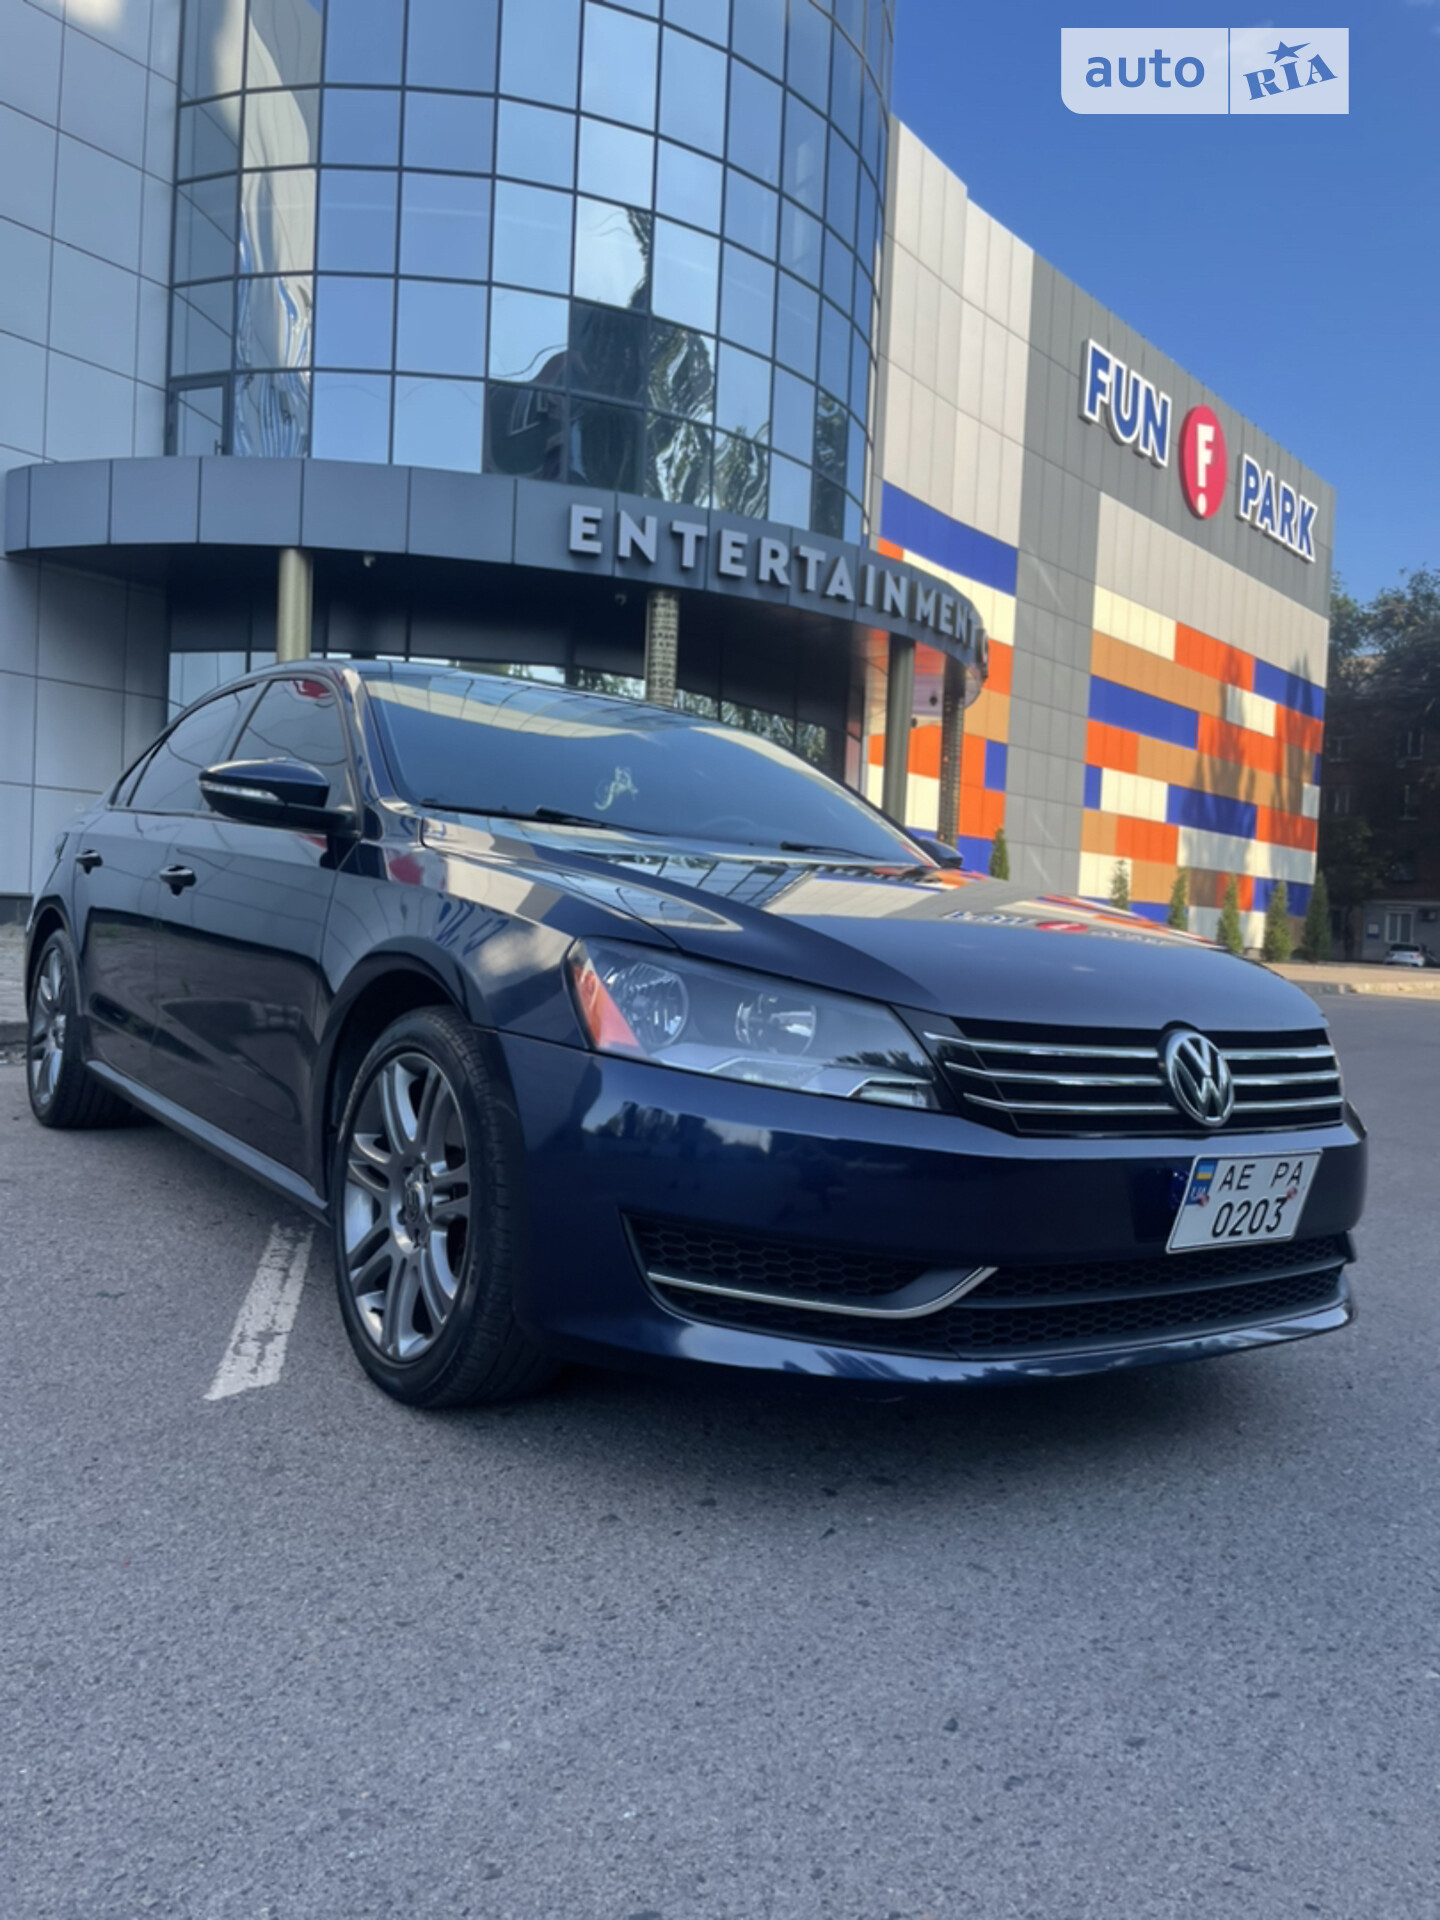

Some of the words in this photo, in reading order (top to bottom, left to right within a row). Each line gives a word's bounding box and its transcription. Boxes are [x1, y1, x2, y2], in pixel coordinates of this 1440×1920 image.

[1084, 338, 1172, 468] FUN
[1239, 453, 1318, 563] PARK
[569, 504, 979, 650] ENTERTAINMENT
[1212, 1196, 1289, 1239] 0203
[1219, 1163, 1256, 1192] AE
[1271, 1161, 1304, 1188] PA
